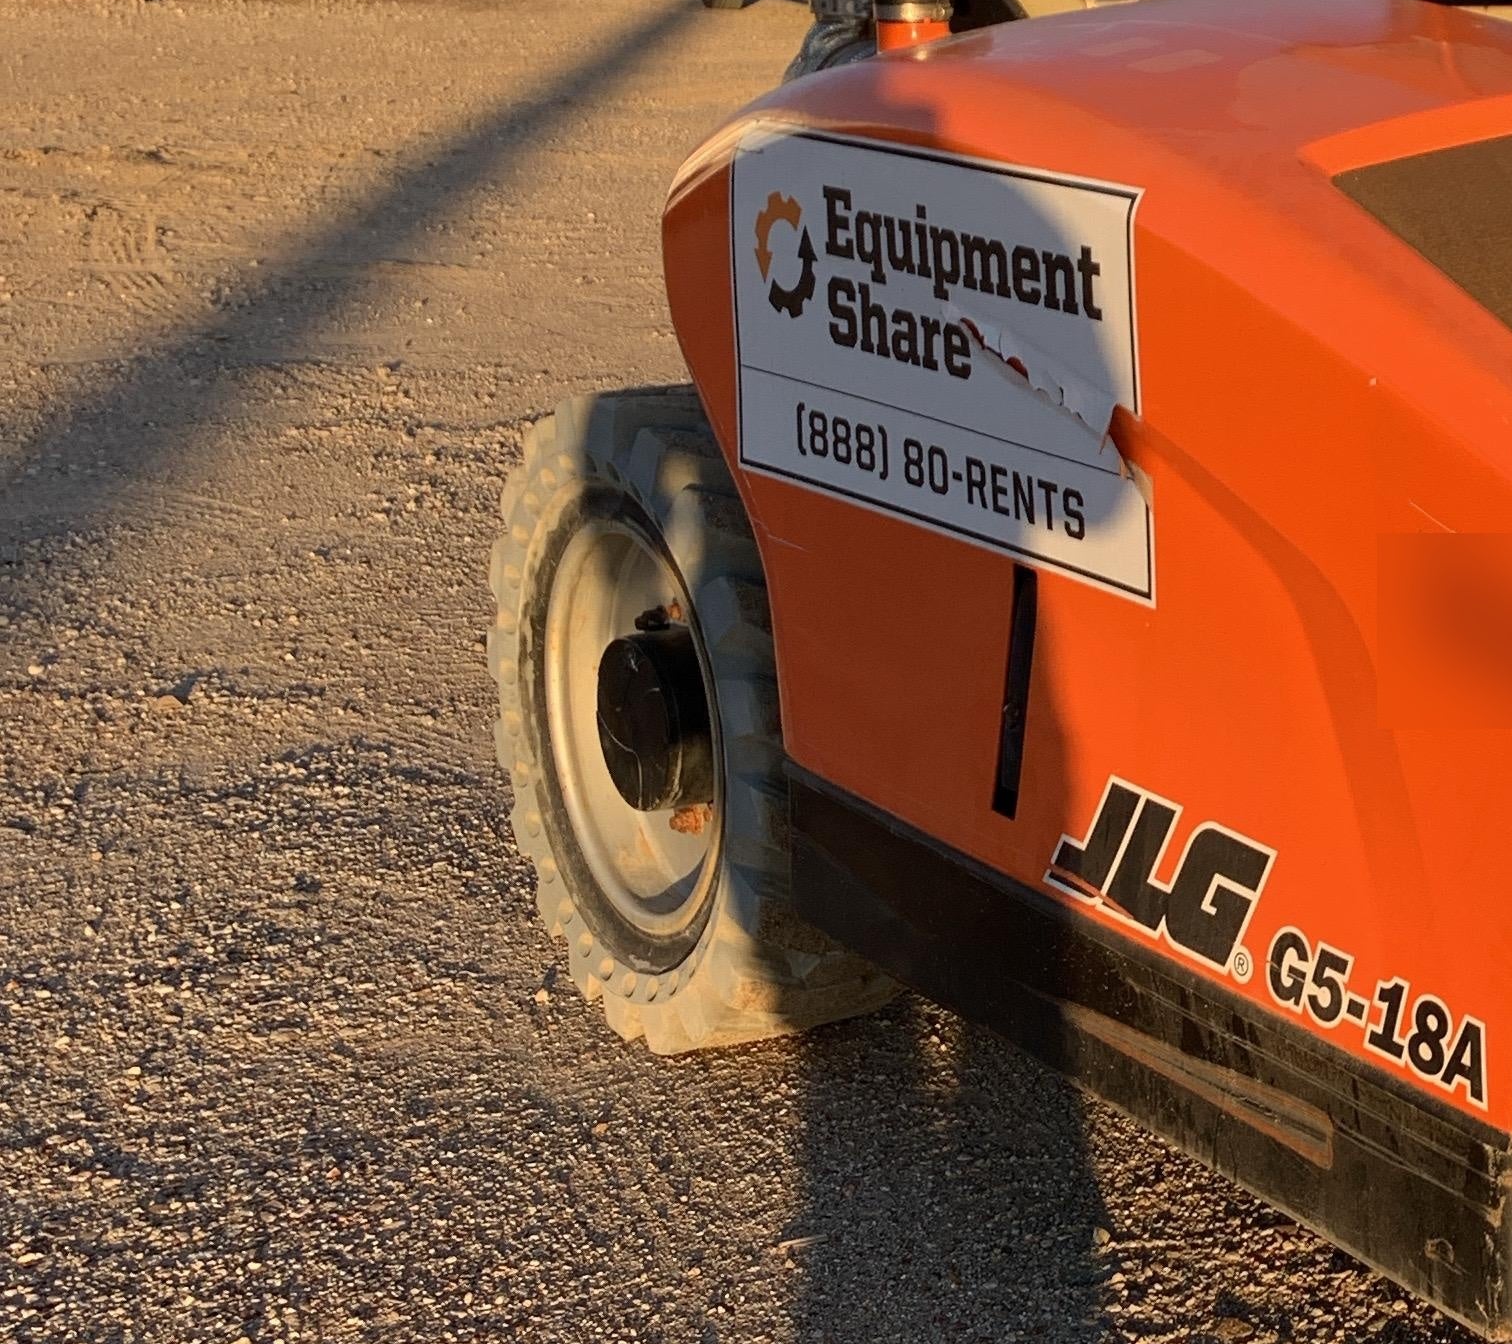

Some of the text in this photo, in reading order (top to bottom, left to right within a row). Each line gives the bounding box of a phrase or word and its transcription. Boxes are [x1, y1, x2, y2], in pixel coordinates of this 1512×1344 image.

[822, 184, 1103, 321] Equipment
[827, 276, 972, 381] Share
[795, 402, 1086, 541] (888) 80-RENTS
[1043, 775, 1489, 1112] JLG G5-18A
